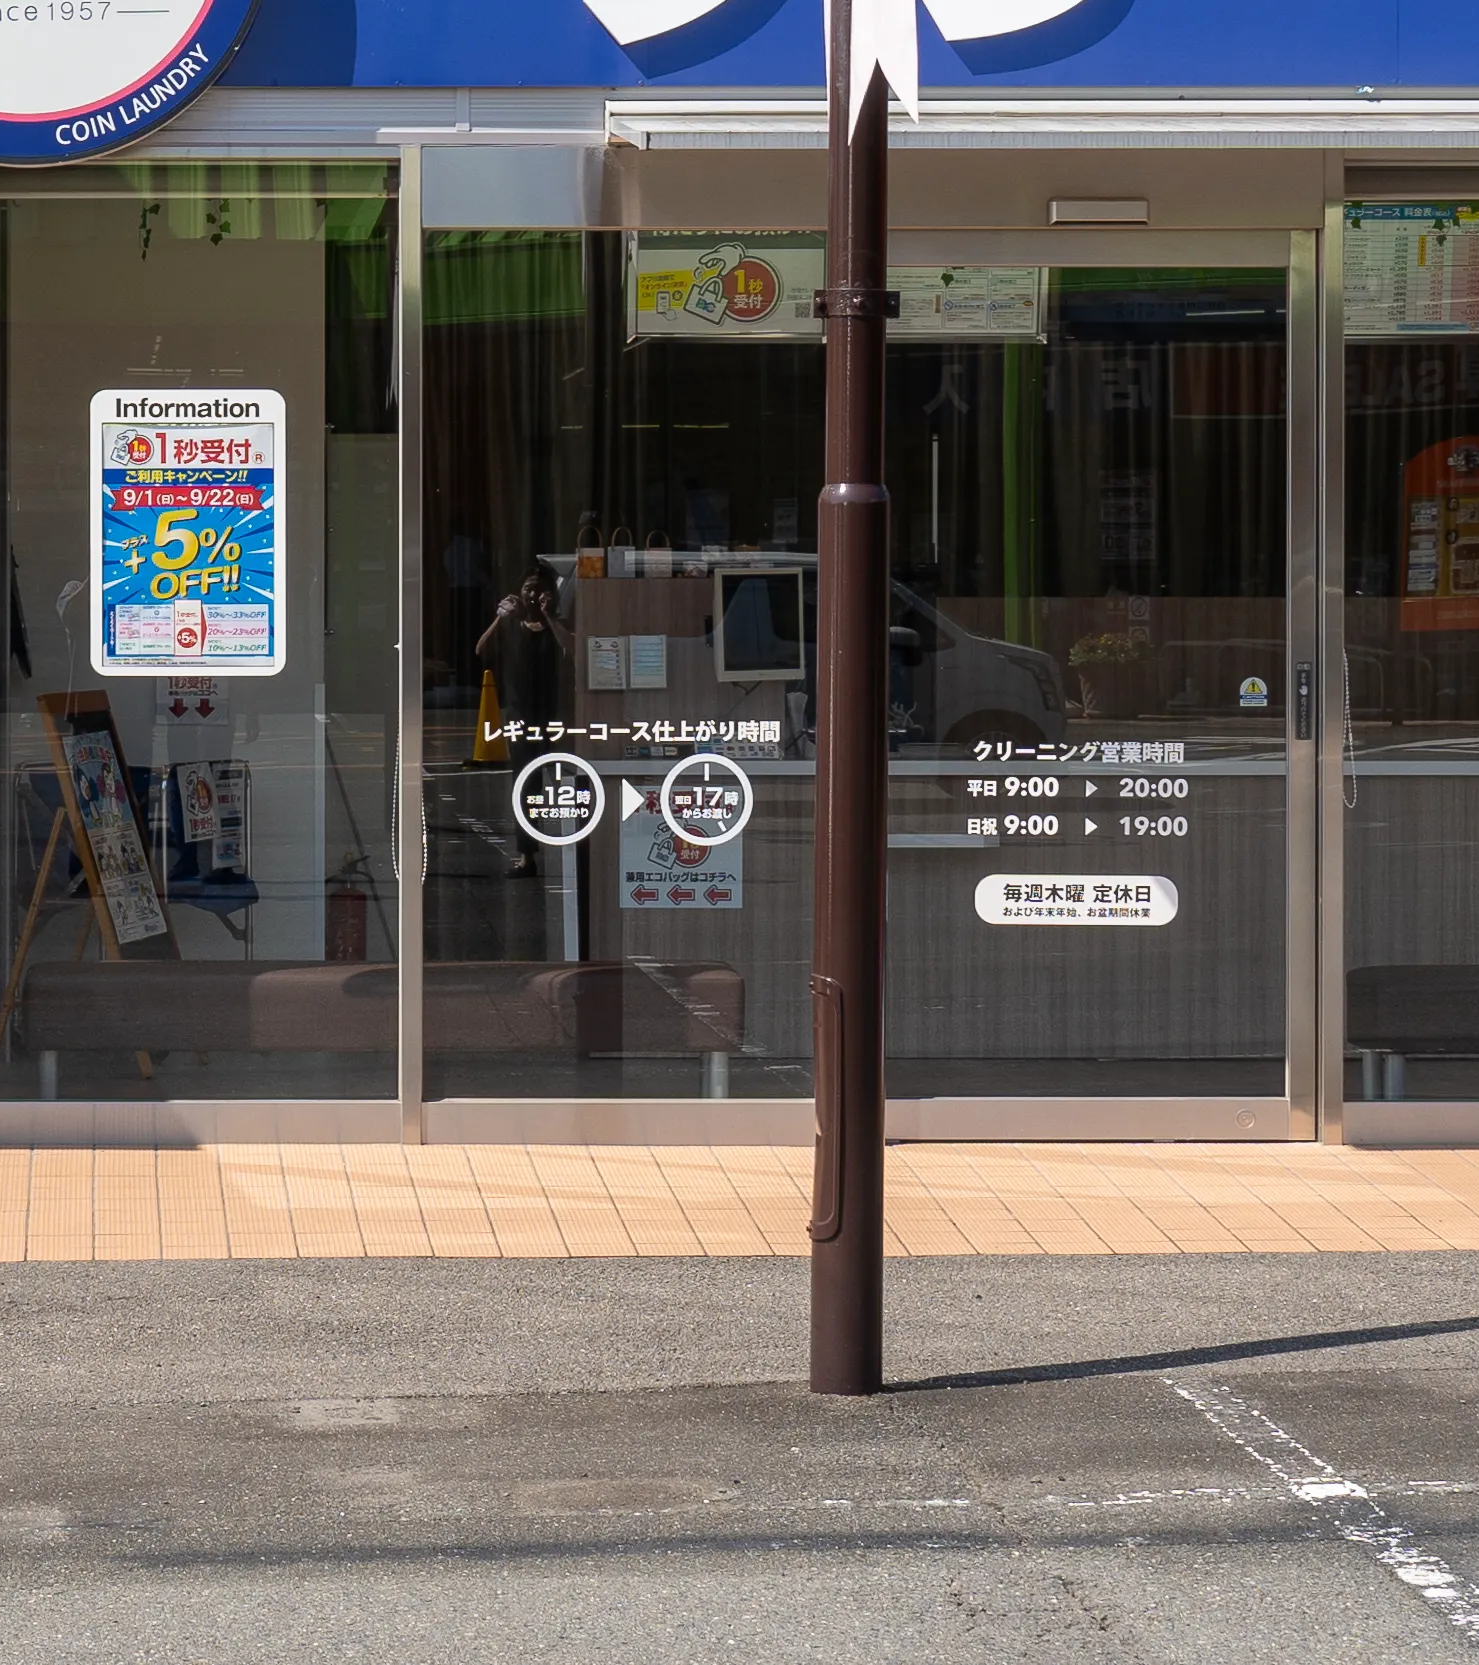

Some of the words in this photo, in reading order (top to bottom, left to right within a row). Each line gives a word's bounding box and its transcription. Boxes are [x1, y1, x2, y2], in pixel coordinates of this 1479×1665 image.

[46, 0, 112, 22] 1957
[54, 111, 116, 146] COIN
[118, 42, 211, 125] LAUNDRY
[734, 294, 764, 309] 受付
[115, 397, 260, 418] Information
[483, 720, 781, 742] レギュラーコース仕上がり時間
[973, 740, 1185, 764] クリーニング営業時間
[967, 780, 998, 797] 平日
[1004, 776, 1059, 798] 9:00
[1119, 778, 1189, 798] 20:00
[529, 807, 589, 819] までお預かり
[967, 818, 998, 836] 日祝
[1003, 815, 1059, 836] 9:00
[1119, 816, 1188, 836] 19:00
[1003, 883, 1085, 903] 毎週木曜
[1093, 883, 1151, 903] 定休日
